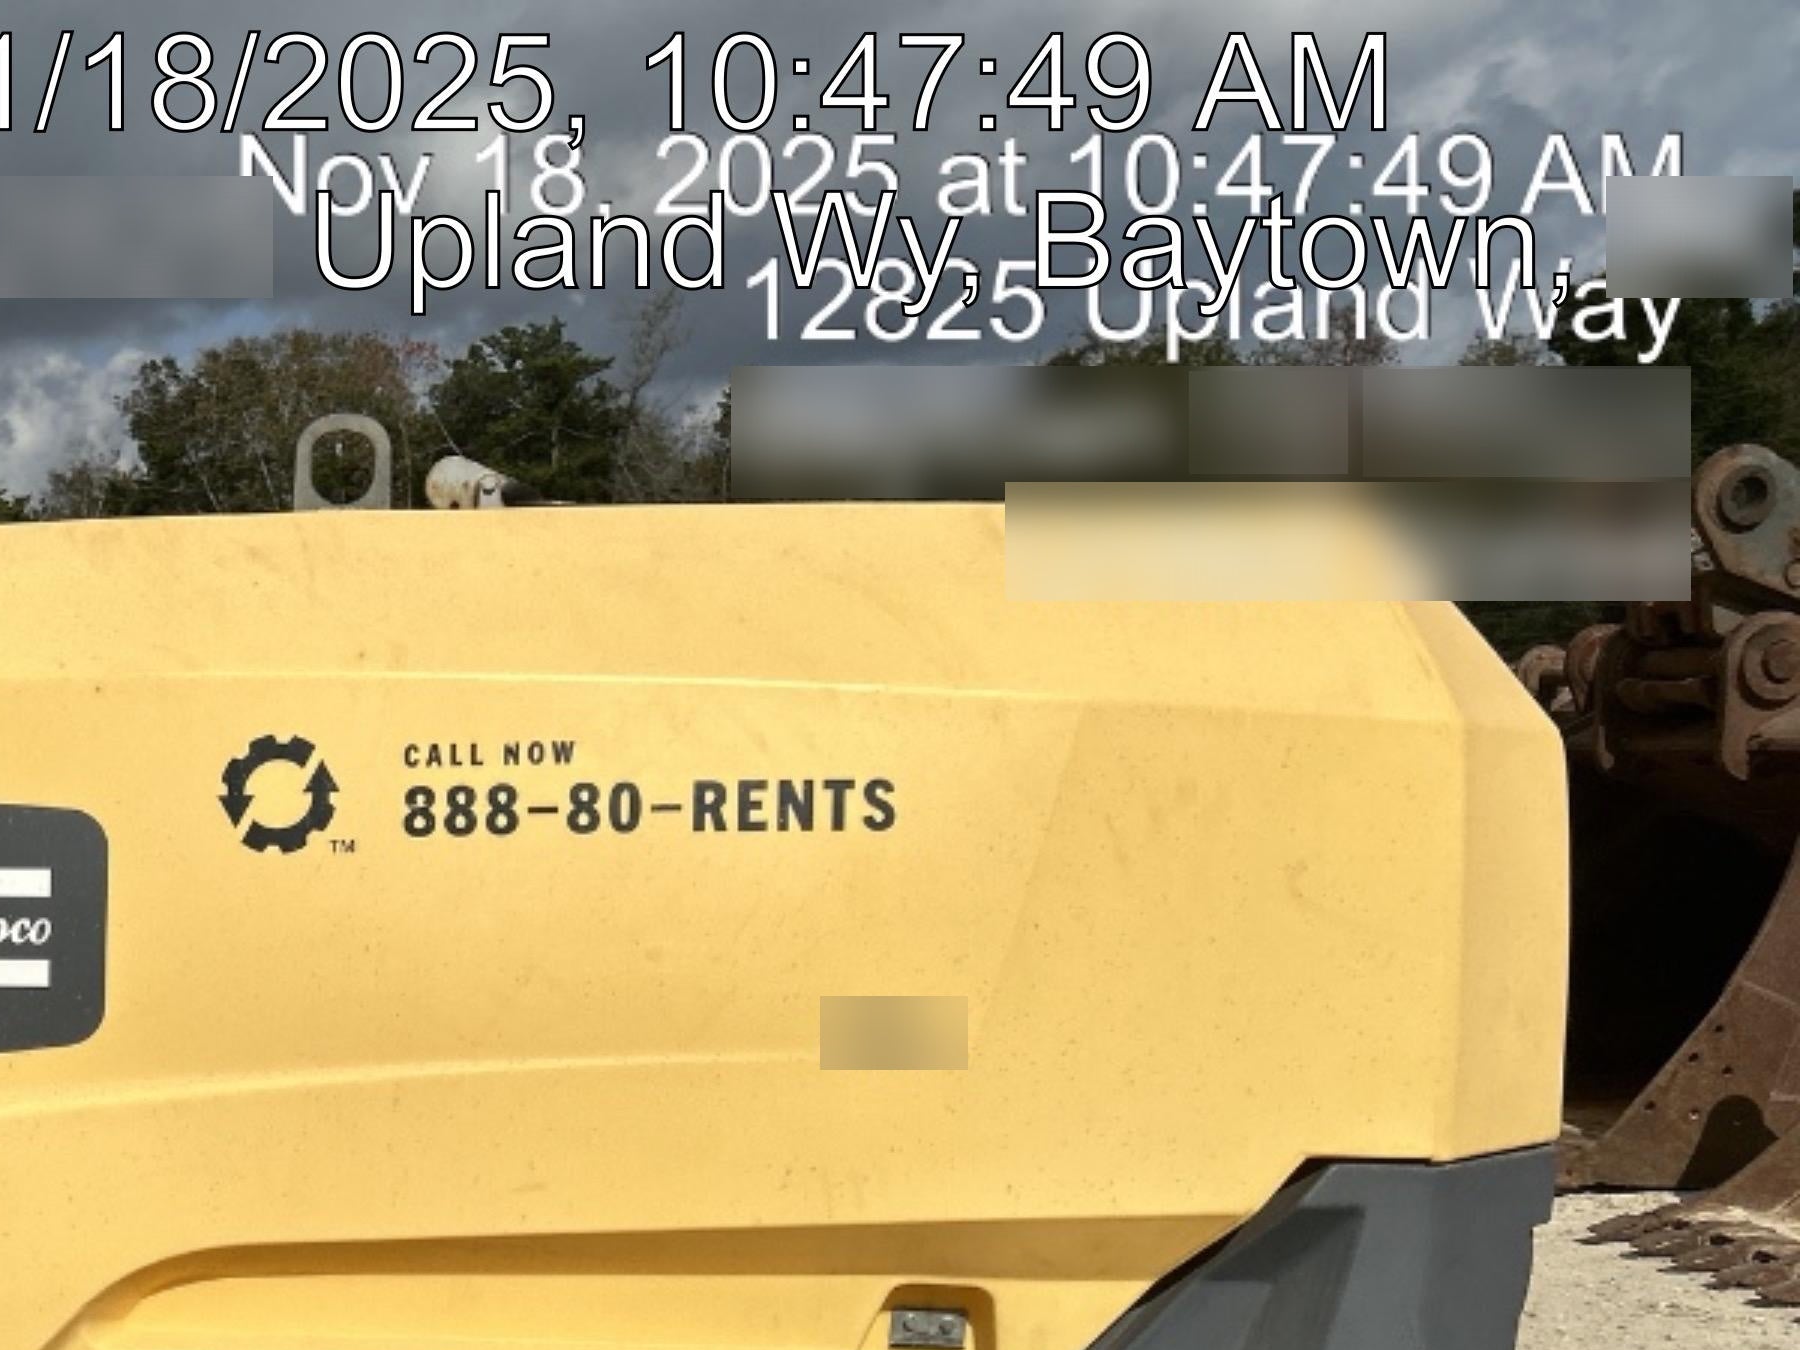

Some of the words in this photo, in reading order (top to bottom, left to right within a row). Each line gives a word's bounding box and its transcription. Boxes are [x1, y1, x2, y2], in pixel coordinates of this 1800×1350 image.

[403, 743, 484, 768] CALL
[503, 741, 576, 767] NOW
[403, 778, 897, 837] 888-80-RENTS
[329, 839, 356, 853] TM
